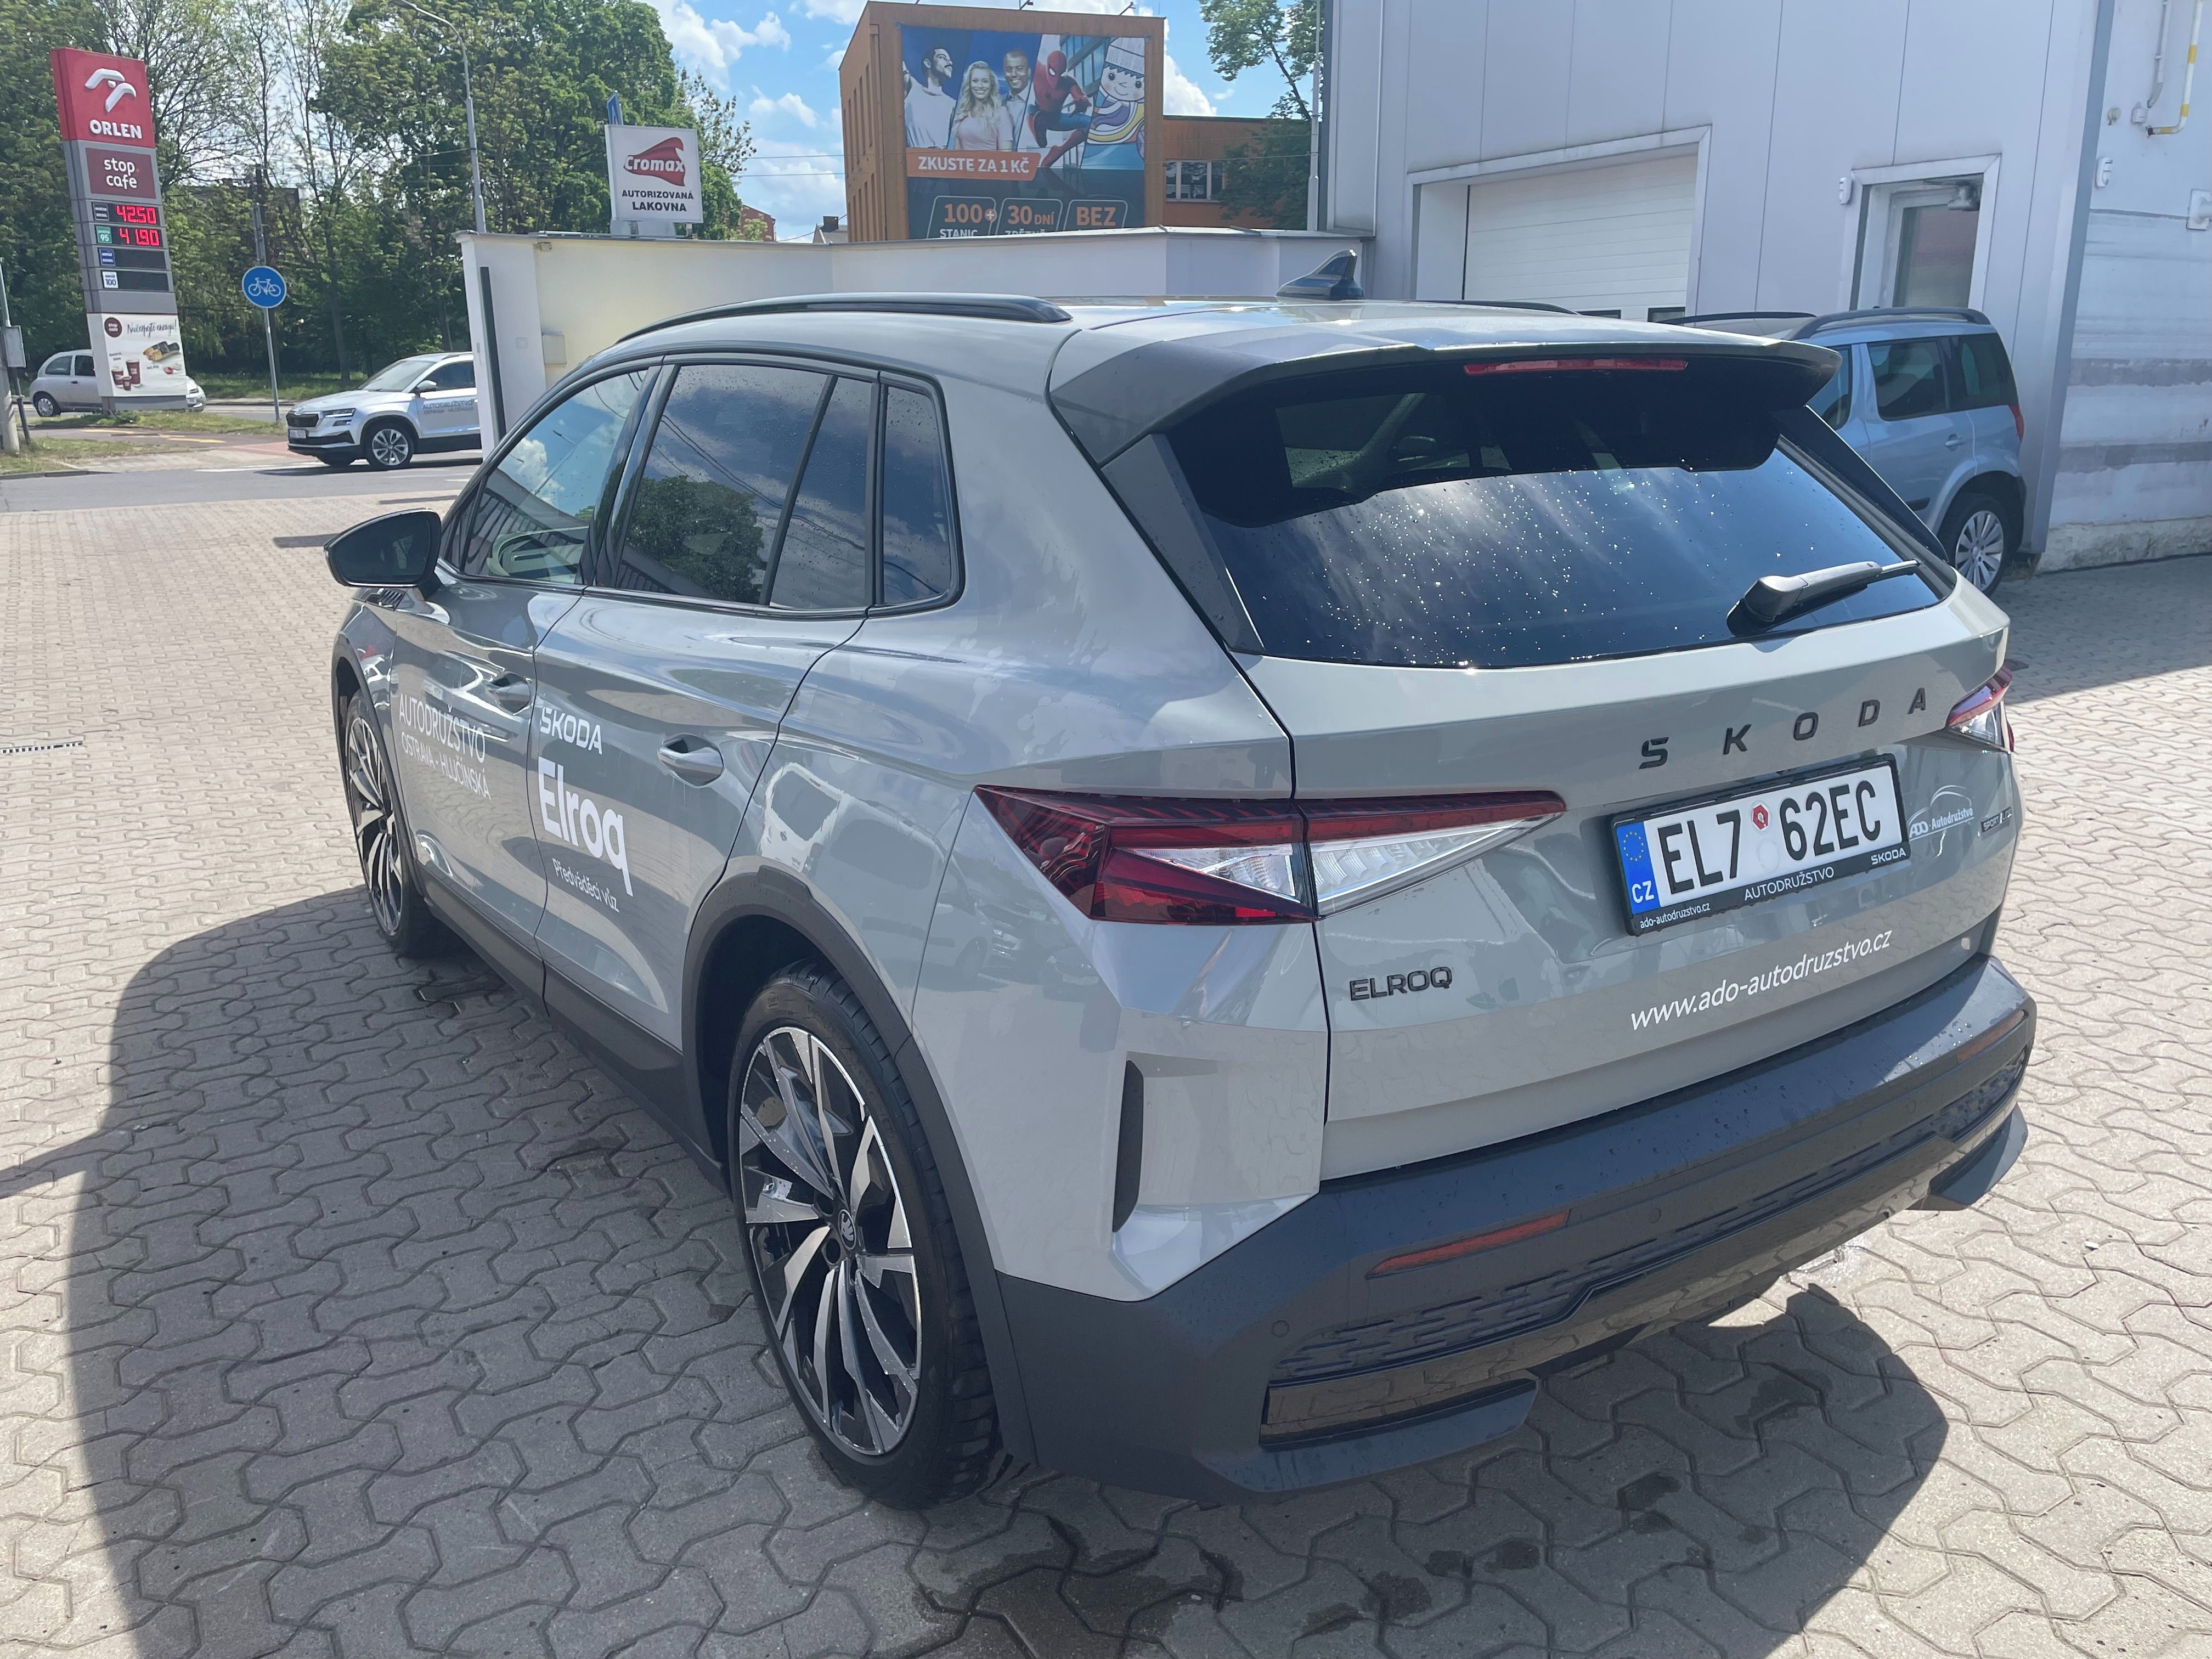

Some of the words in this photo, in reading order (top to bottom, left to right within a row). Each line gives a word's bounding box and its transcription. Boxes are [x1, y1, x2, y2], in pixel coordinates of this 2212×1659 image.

[89, 119, 142, 139] ORLEN
[104, 157, 135, 176] stop
[918, 156, 974, 171] ZKUSTE
[978, 159, 997, 172] ZA
[1000, 160, 1008, 173] 1
[1011, 157, 1029, 173] KČ
[106, 174, 137, 189] cafe
[622, 190, 694, 199] AUTORIZOVANÁ
[632, 201, 687, 211] LAKOVNA
[1008, 205, 1032, 224] 30
[1034, 212, 1055, 225] DNÍ
[1076, 207, 1116, 226] BEZ
[399, 693, 486, 764] AUTODRUŽSTVO
[401, 731, 436, 770] OSTRAVA
[439, 752, 492, 802] HLUČÍNSKÁ
[538, 755, 634, 898] Elroq
[1657, 809, 1742, 895] EL7
[1779, 780, 1882, 861] 62EC
[1632, 880, 1655, 904] CZ
[1744, 866, 1835, 901] AUTODRUŽSTVO
[601, 887, 620, 913] vůz
[1639, 902, 1711, 929] ado-autodruzstvo.cz
[1349, 966, 1453, 1001] ELROQ
[1630, 929, 1893, 1031] www.ado-autodruzstvo.cz
